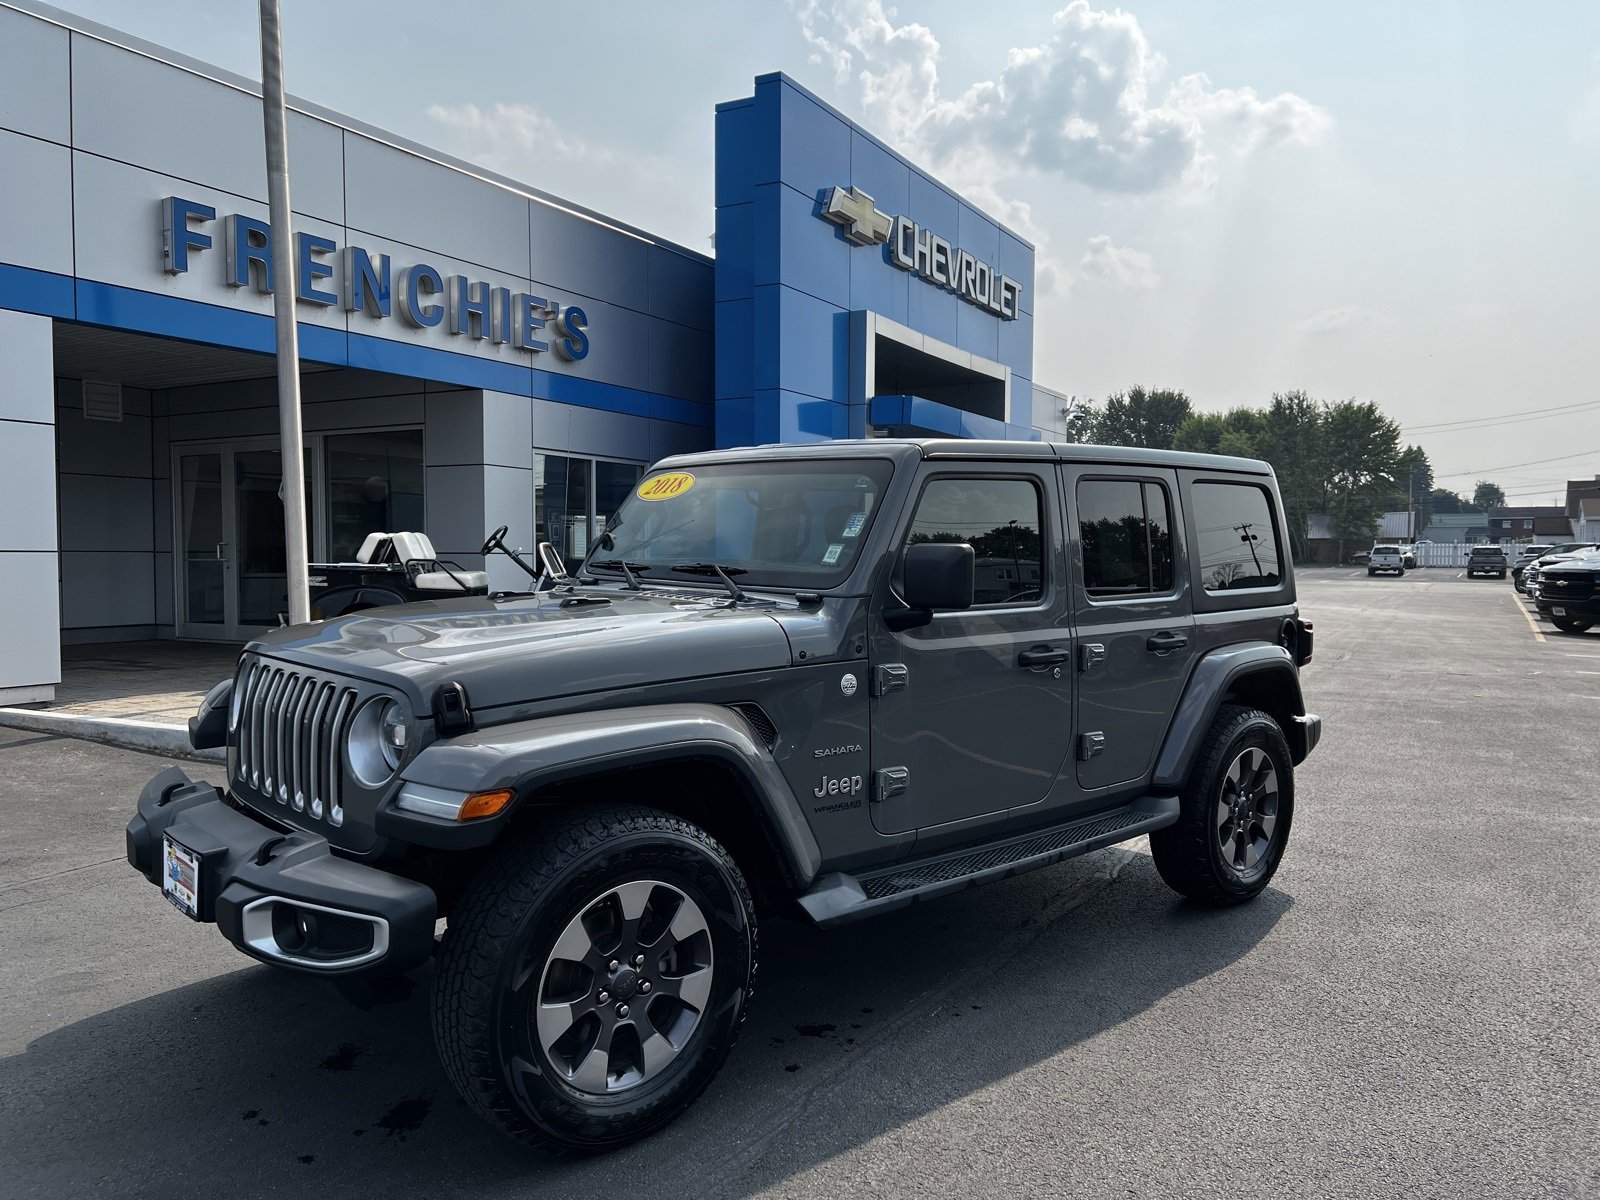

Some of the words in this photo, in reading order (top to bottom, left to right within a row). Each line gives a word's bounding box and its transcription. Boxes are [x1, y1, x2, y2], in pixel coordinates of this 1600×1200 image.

[163, 196, 590, 361] FRENCHIE'S
[892, 214, 1023, 321] CHEVROLET
[642, 476, 688, 495] 2018
[814, 744, 862, 758] SAHARA
[813, 775, 863, 798] Jeep
